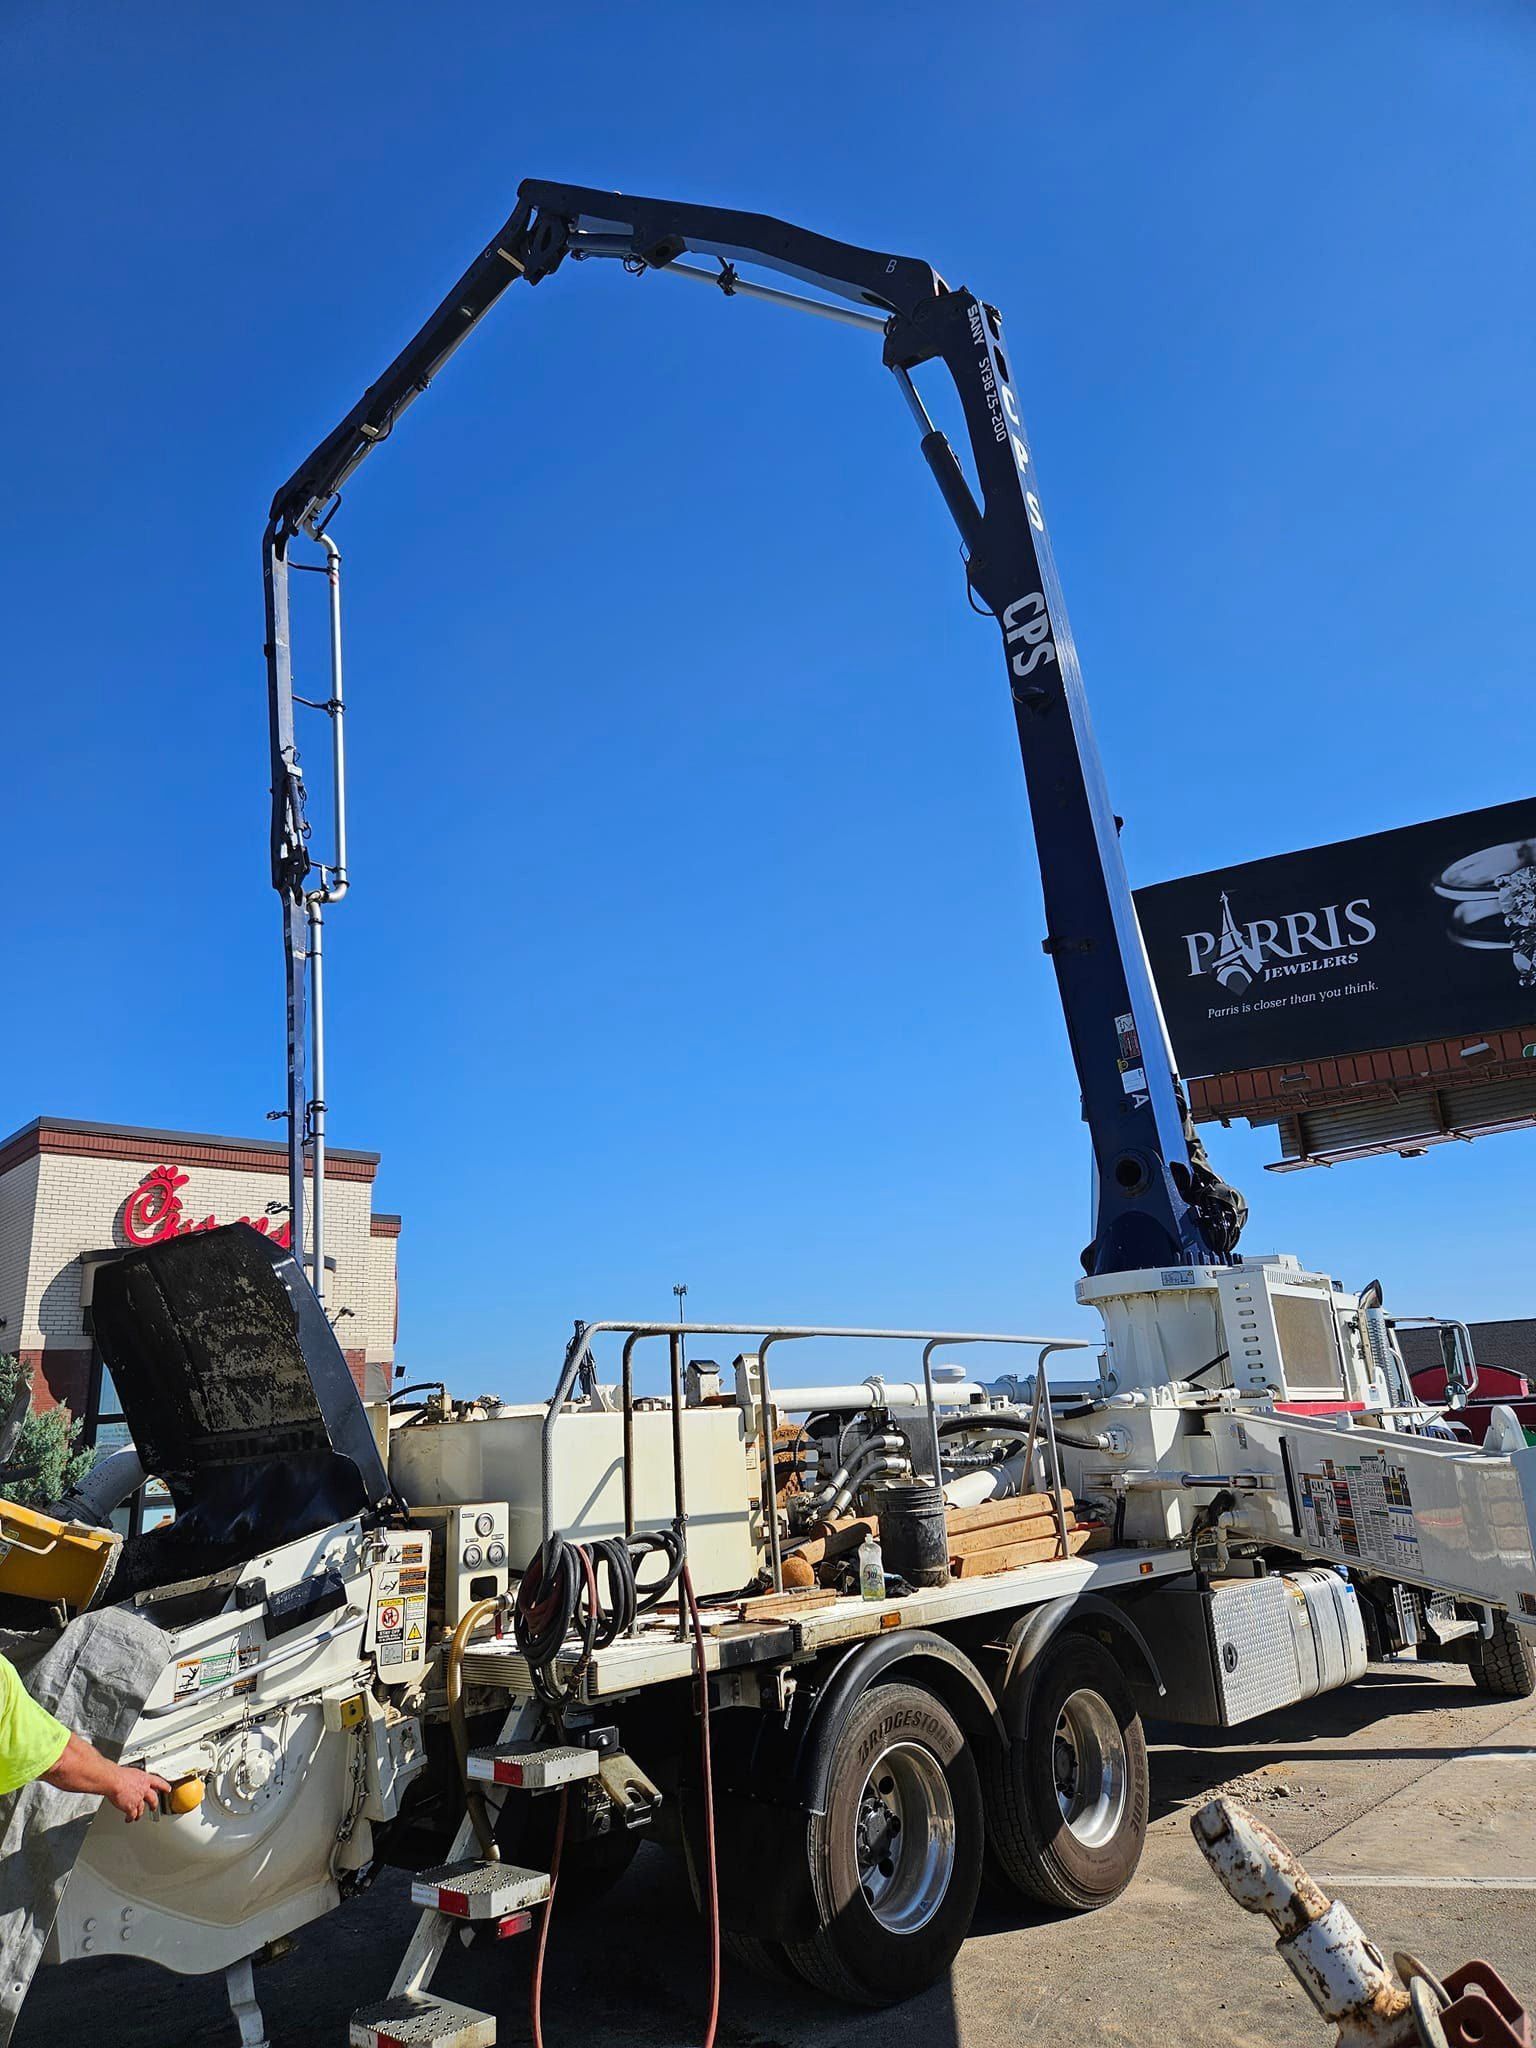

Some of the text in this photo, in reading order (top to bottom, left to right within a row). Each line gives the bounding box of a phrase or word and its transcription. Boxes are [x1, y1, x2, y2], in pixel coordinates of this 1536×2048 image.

[885, 258, 898, 273] B
[967, 303, 986, 346] SANY
[1003, 591, 1056, 677] CPS
[1181, 892, 1377, 984] PARRIS
[1263, 952, 1359, 983] JEWELERS
[1207, 980, 1379, 1019] Parris is closer than you think.
[1131, 1093, 1150, 1110] A
[858, 1709, 955, 1767] BRIDGESTONE
